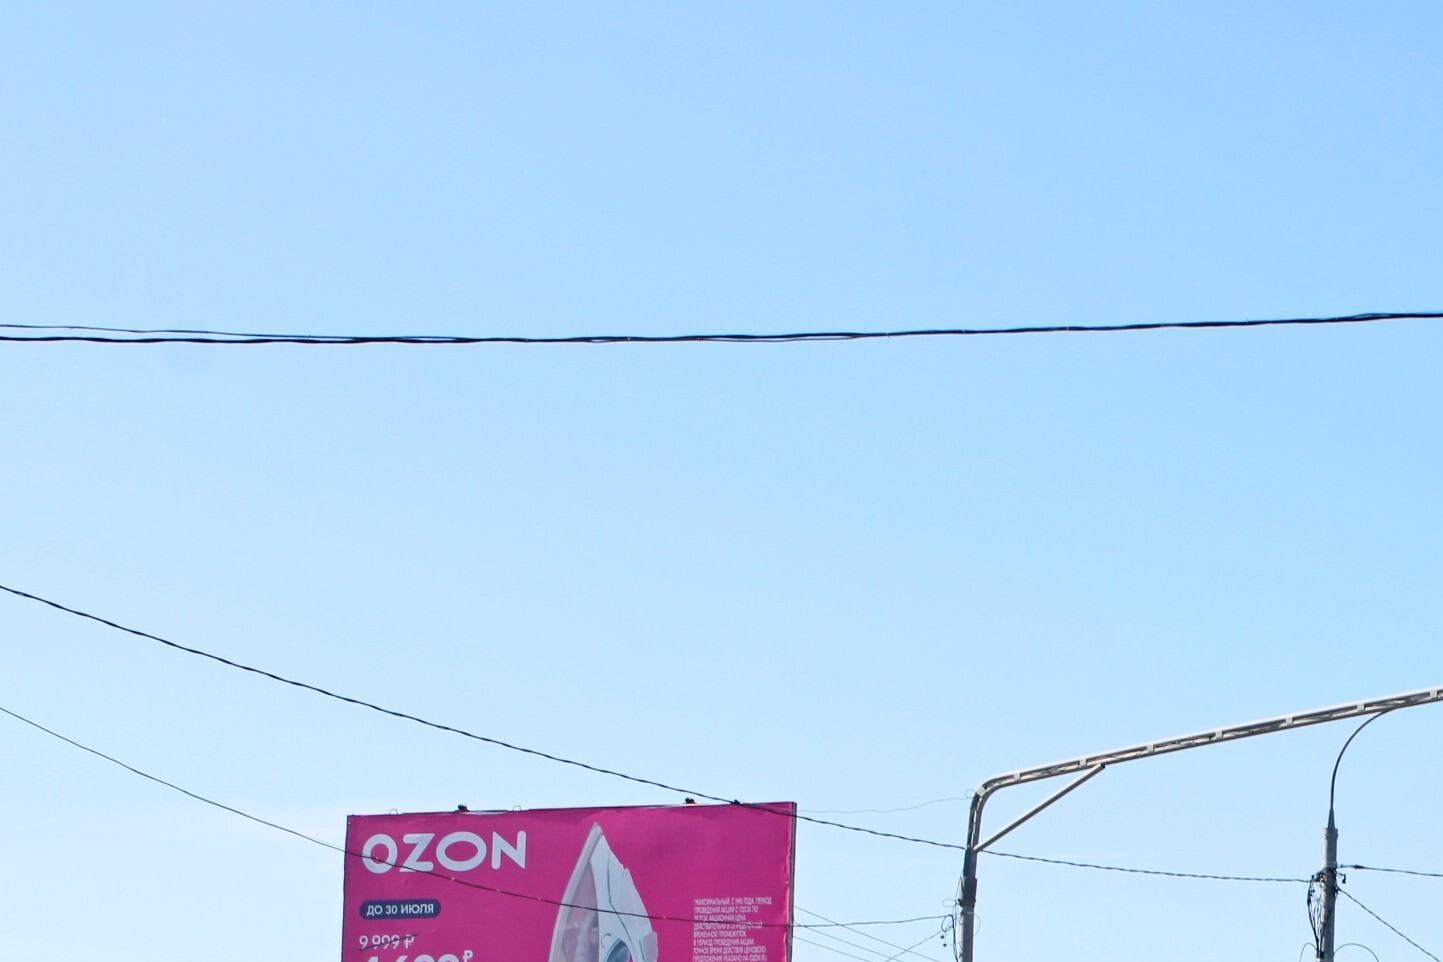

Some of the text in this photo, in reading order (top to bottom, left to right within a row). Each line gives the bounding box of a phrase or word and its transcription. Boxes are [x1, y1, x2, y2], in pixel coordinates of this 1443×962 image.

[362, 830, 527, 874] OZON
[366, 904, 434, 916] ДО 30 ИЮЛЯ
[359, 935, 368, 949] 9
[371, 934, 400, 949] 999
